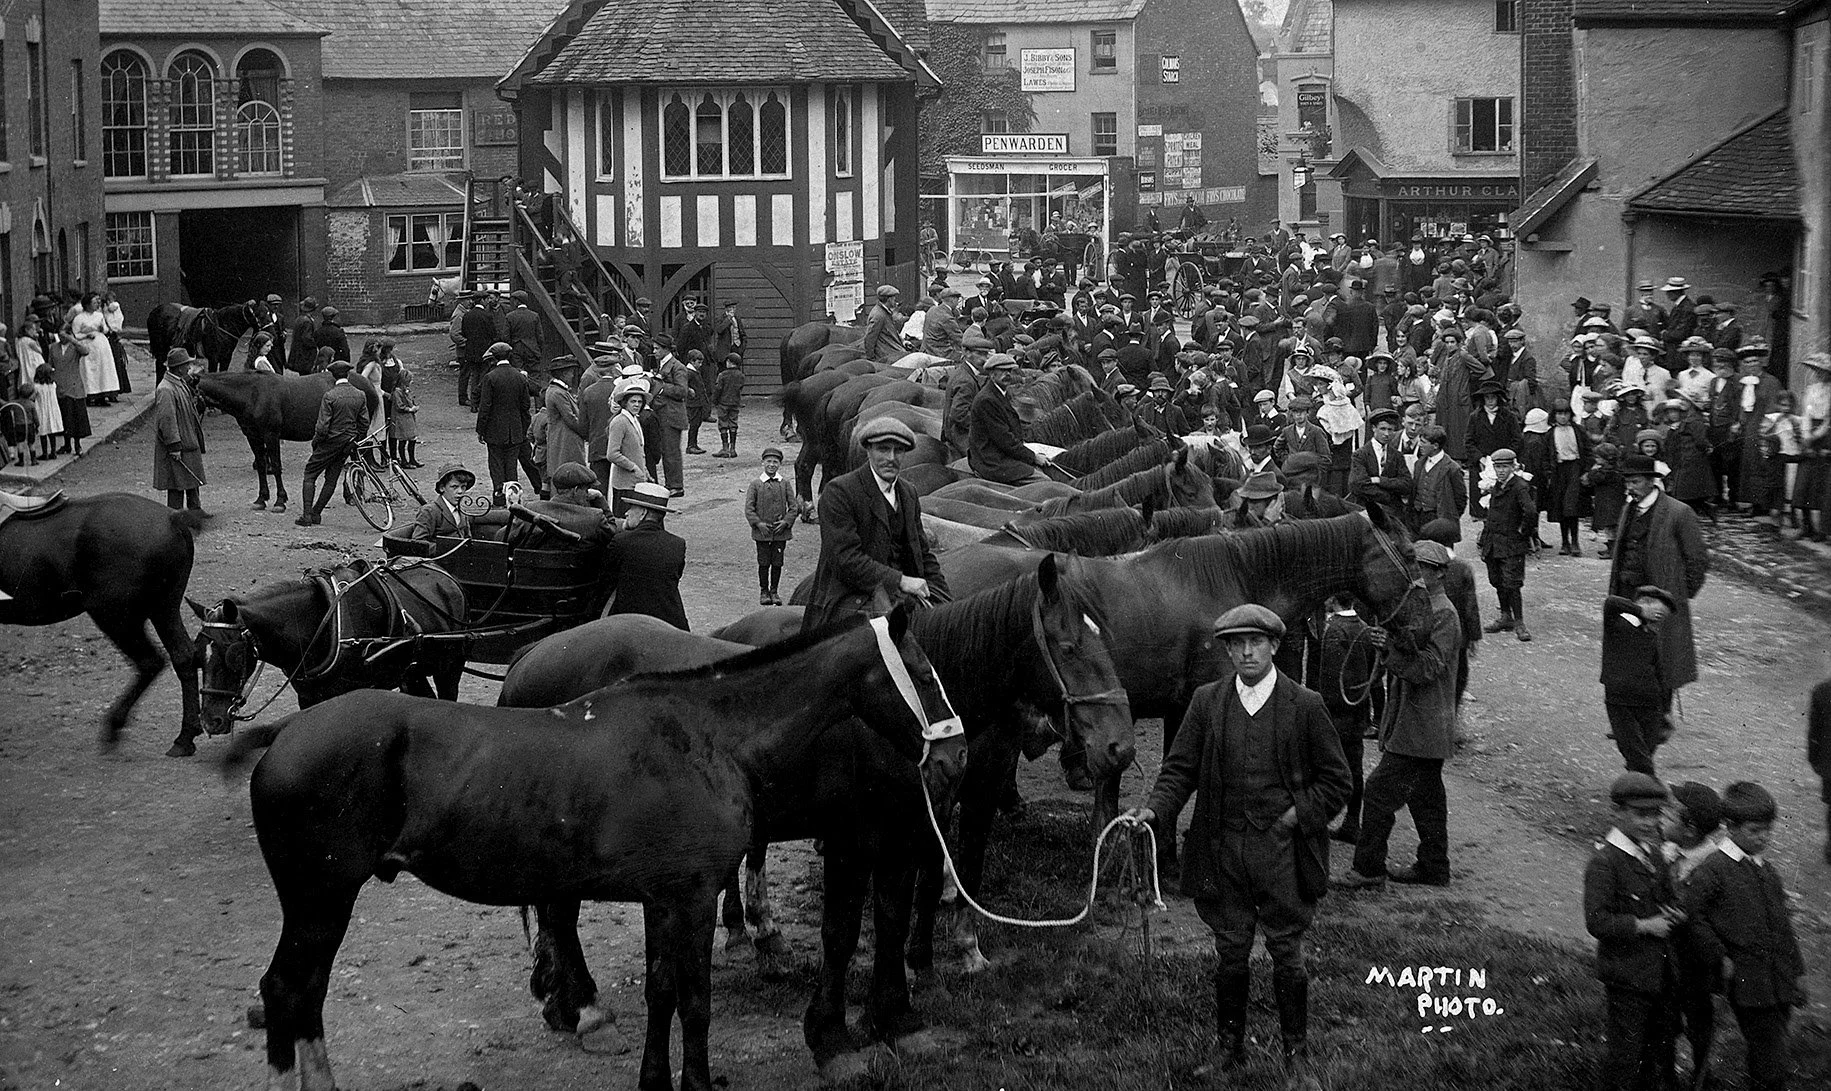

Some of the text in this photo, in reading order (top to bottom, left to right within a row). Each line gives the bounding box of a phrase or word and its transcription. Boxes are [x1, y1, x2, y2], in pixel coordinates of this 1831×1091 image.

[1054, 53, 1073, 62] SONS
[1023, 66, 1045, 74] JOSEPH
[1162, 70, 1179, 82] STARCH
[1023, 78, 1047, 86] LAWES
[481, 114, 516, 125] RED
[984, 137, 1063, 151] PENWARDEN
[968, 163, 1005, 171] SEEDSMAN
[1049, 163, 1078, 171] GROCER
[1398, 186, 1472, 196] ARTHUR
[828, 249, 862, 261] ONSLOW
